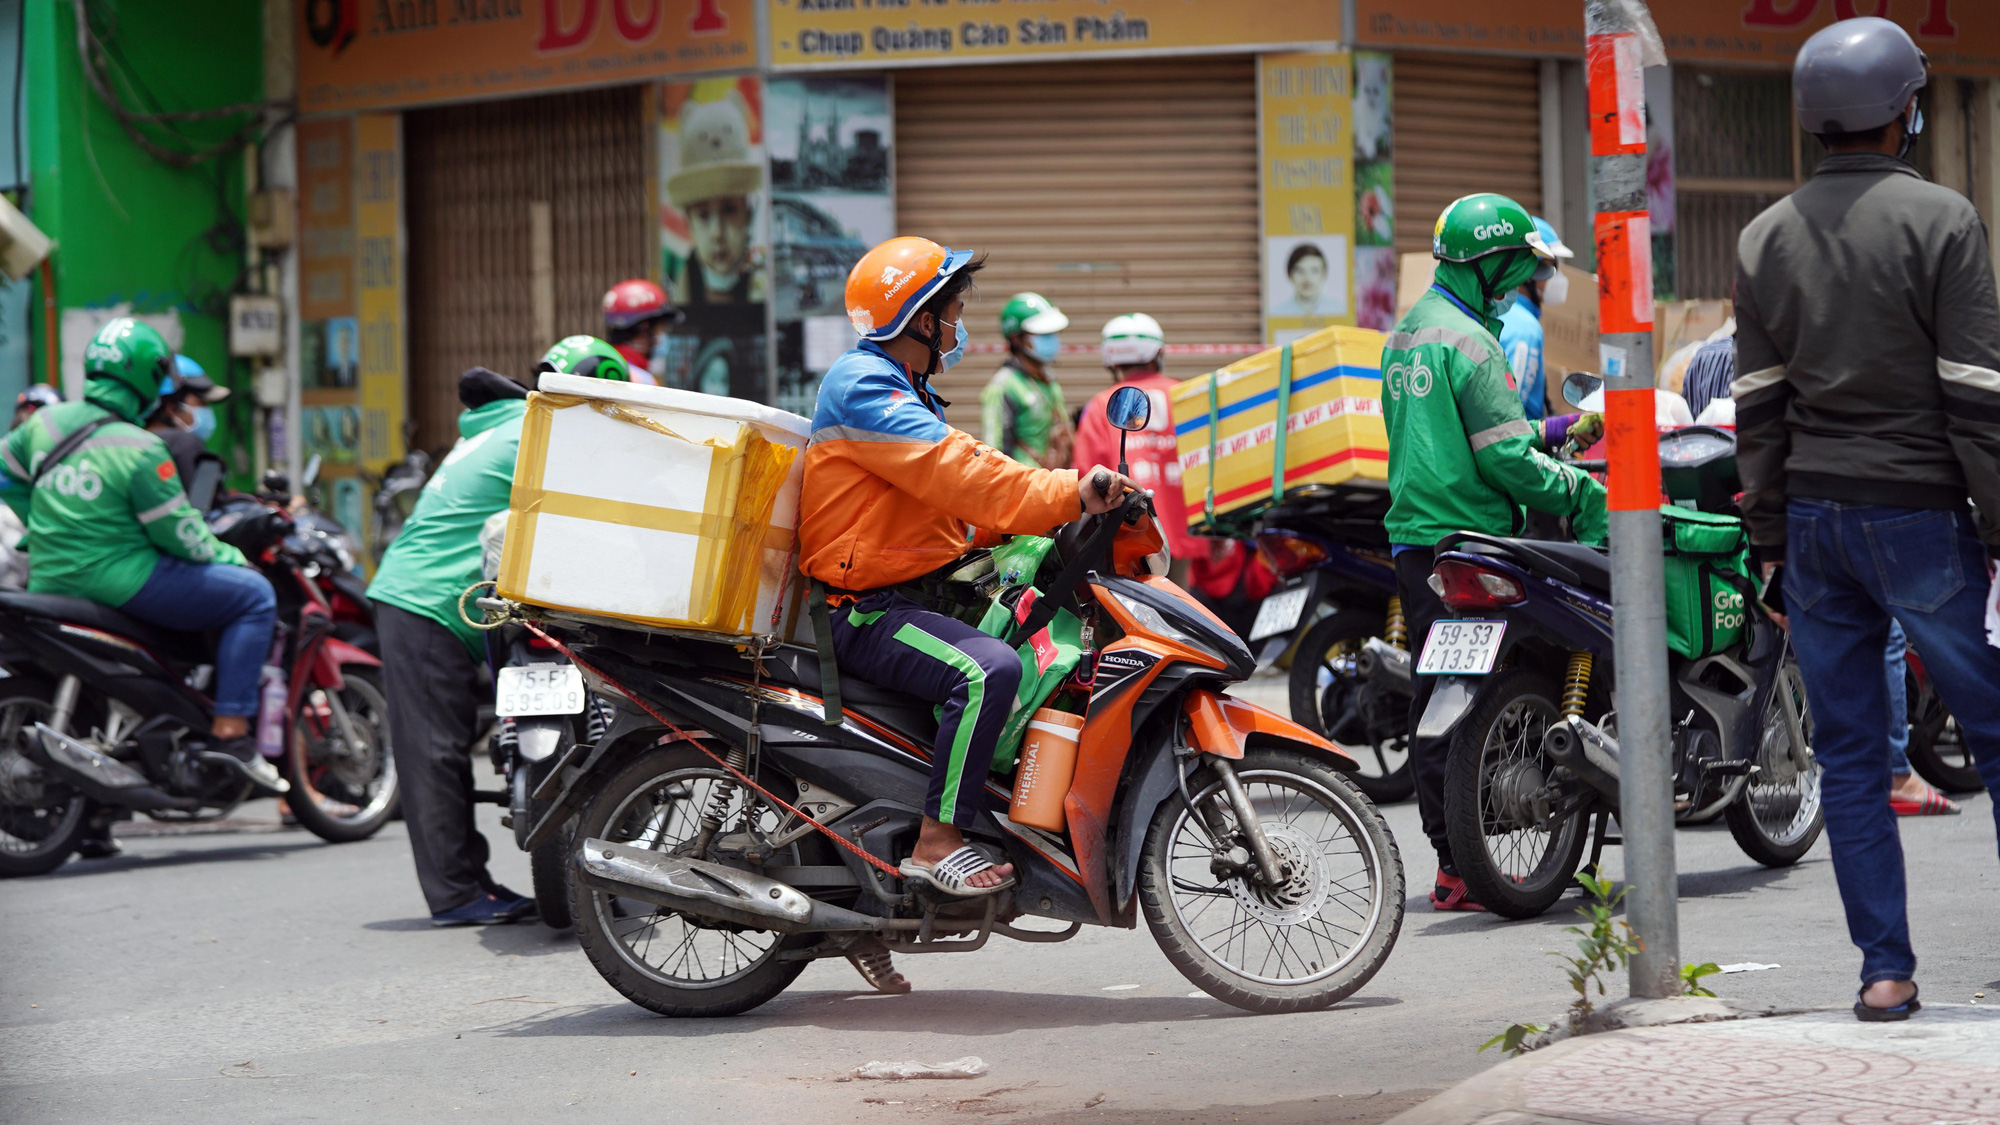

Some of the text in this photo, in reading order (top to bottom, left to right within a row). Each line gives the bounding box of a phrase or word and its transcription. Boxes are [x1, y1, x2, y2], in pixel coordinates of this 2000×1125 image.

[799, 29, 864, 57] Chụp
[871, 22, 952, 51] Quảng
[961, 20, 1010, 47] Cáo
[1271, 157, 1344, 189] PASSPORT
[1473, 218, 1514, 241] Grab
[884, 270, 916, 301] AhaMove
[1715, 611, 1746, 630] Foo
[1438, 624, 1494, 646] 59-S3
[1104, 655, 1146, 668] HONDA
[1424, 648, 1490, 670] 413.51
[504, 691, 577, 713] 595.09
[791, 729, 819, 741] 110
[1016, 741, 1040, 808] THERMAL
